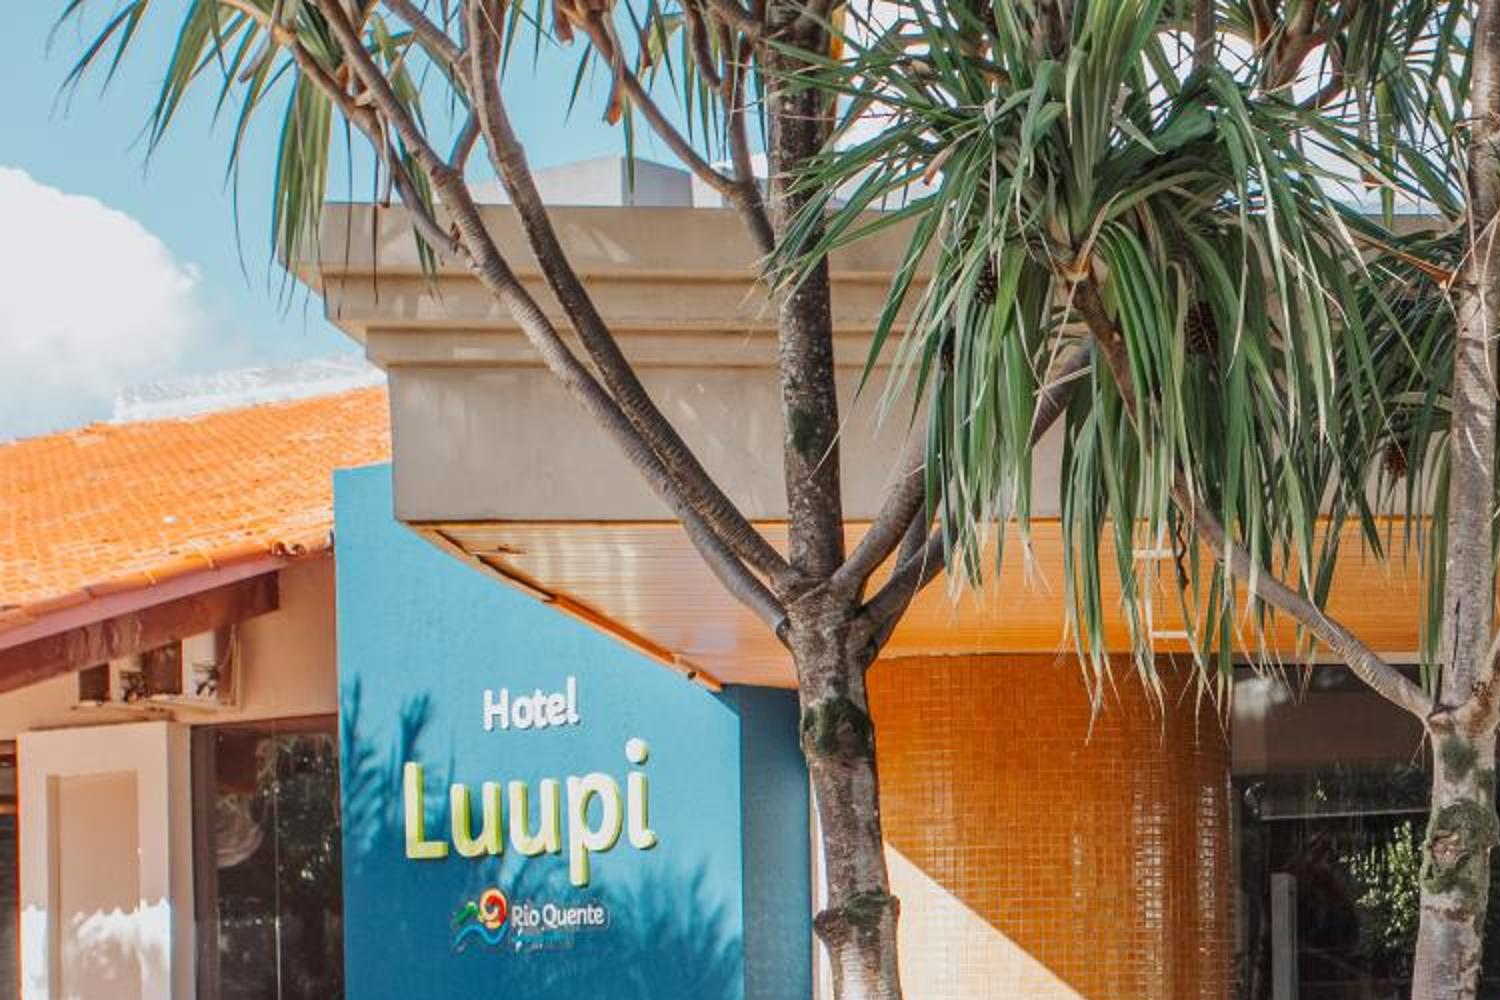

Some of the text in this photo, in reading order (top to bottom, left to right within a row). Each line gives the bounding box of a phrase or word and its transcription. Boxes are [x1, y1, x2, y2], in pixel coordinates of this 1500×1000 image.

[483, 676, 580, 731] Hotel
[404, 737, 657, 887] Luupi
[511, 903, 606, 929] Rio Quente
